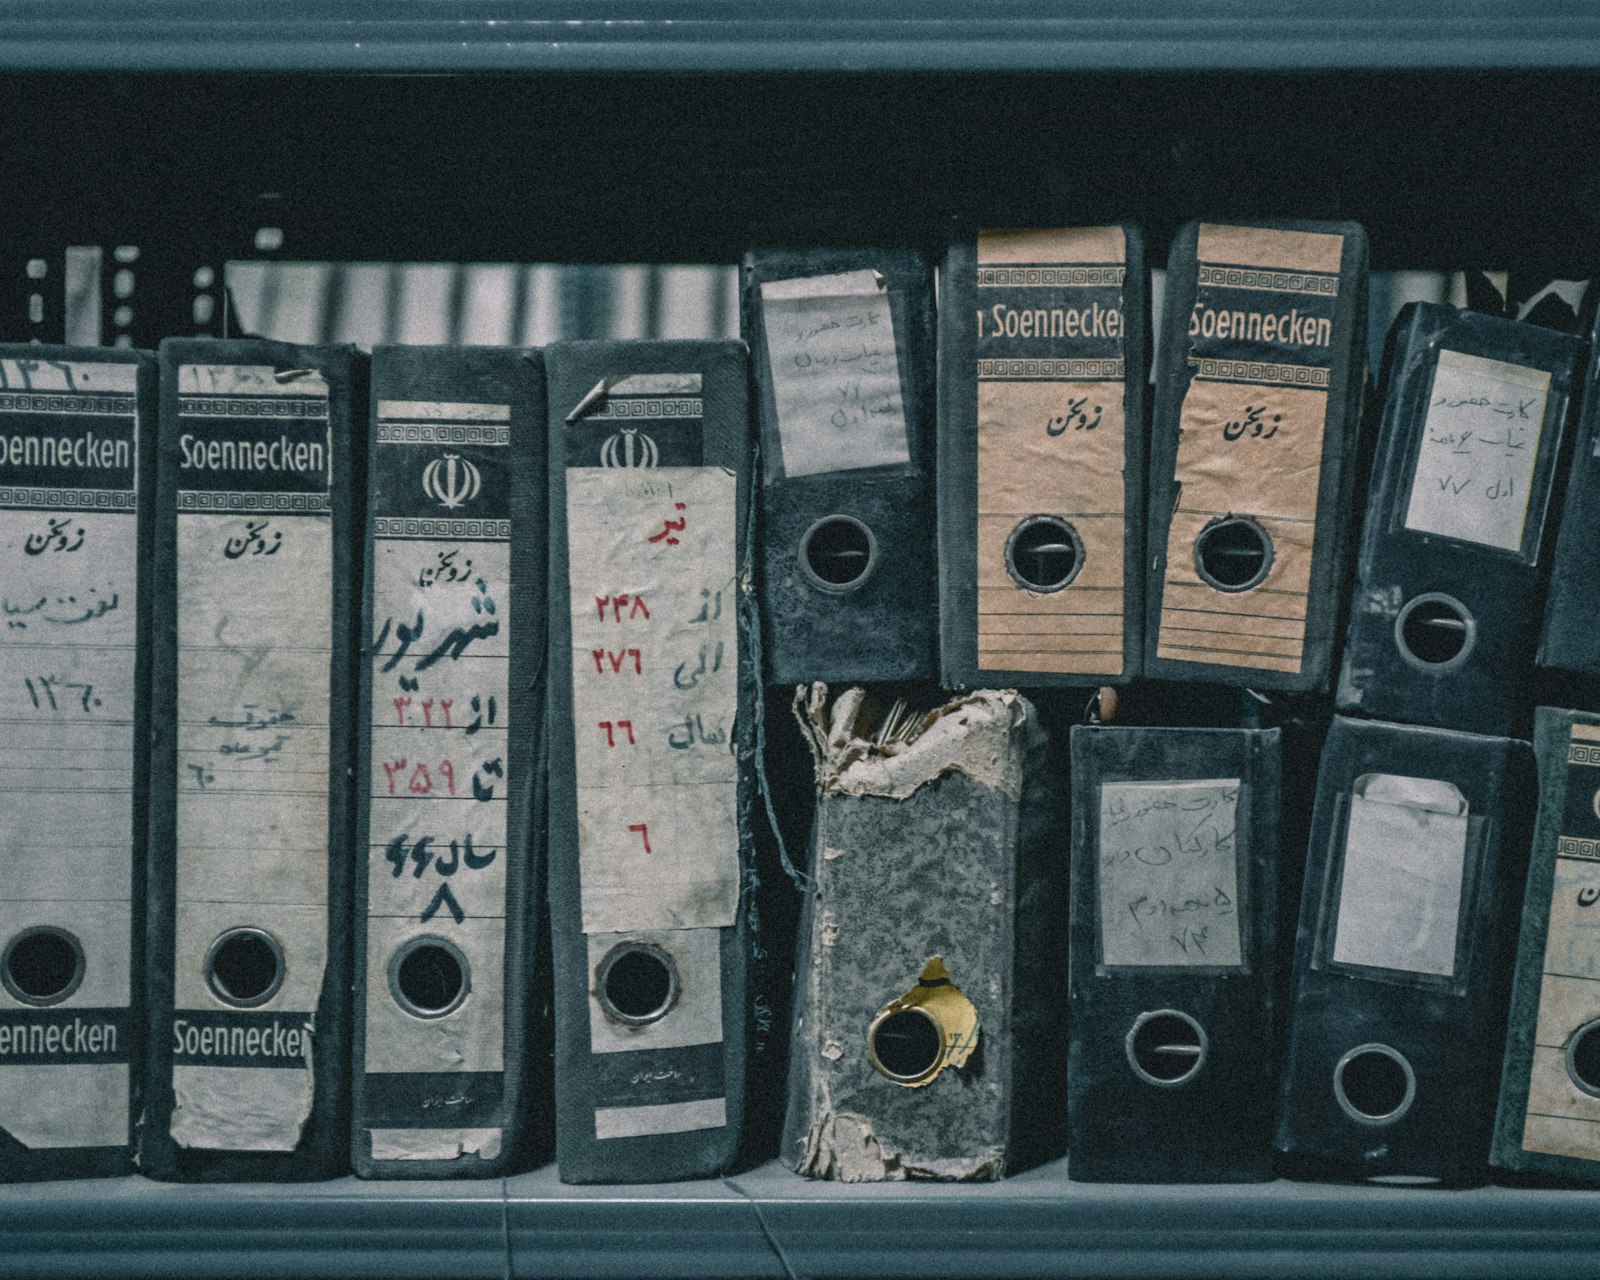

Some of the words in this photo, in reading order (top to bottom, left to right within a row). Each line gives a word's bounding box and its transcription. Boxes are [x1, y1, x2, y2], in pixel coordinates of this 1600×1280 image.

[1187, 303, 1331, 347] Soennecken
[180, 434, 323, 472] Soennecken
[688, 588, 722, 623] از
[667, 711, 727, 750] سال
[383, 757, 456, 796] ۳۵۹
[434, 833, 497, 878] سال
[420, 882, 465, 925] ۸
